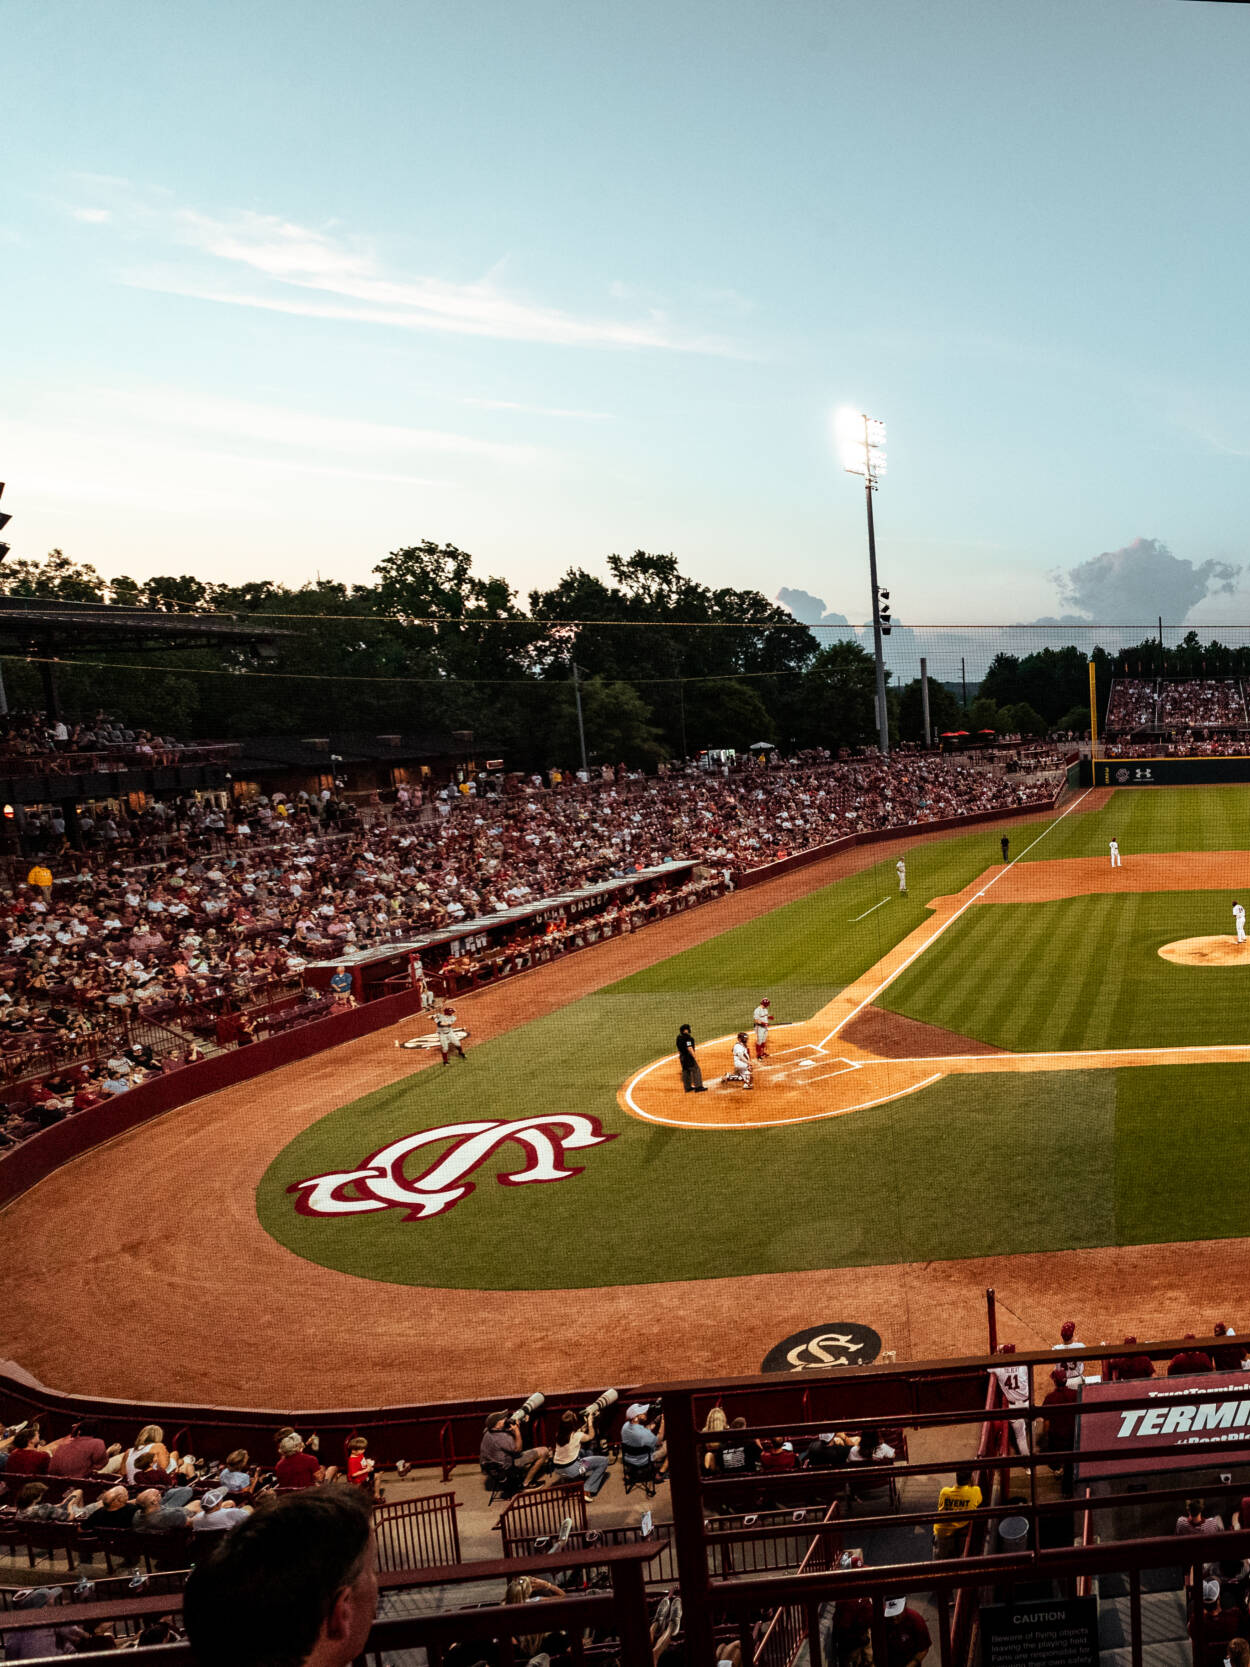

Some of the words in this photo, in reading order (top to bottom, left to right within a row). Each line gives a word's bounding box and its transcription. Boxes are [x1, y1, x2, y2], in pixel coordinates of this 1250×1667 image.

[1004, 1375, 1020, 1390] 41
[944, 1499, 970, 1507] EVENT
[1013, 1611, 1066, 1624] CAUTION
[1038, 1639, 1068, 1650] playing
